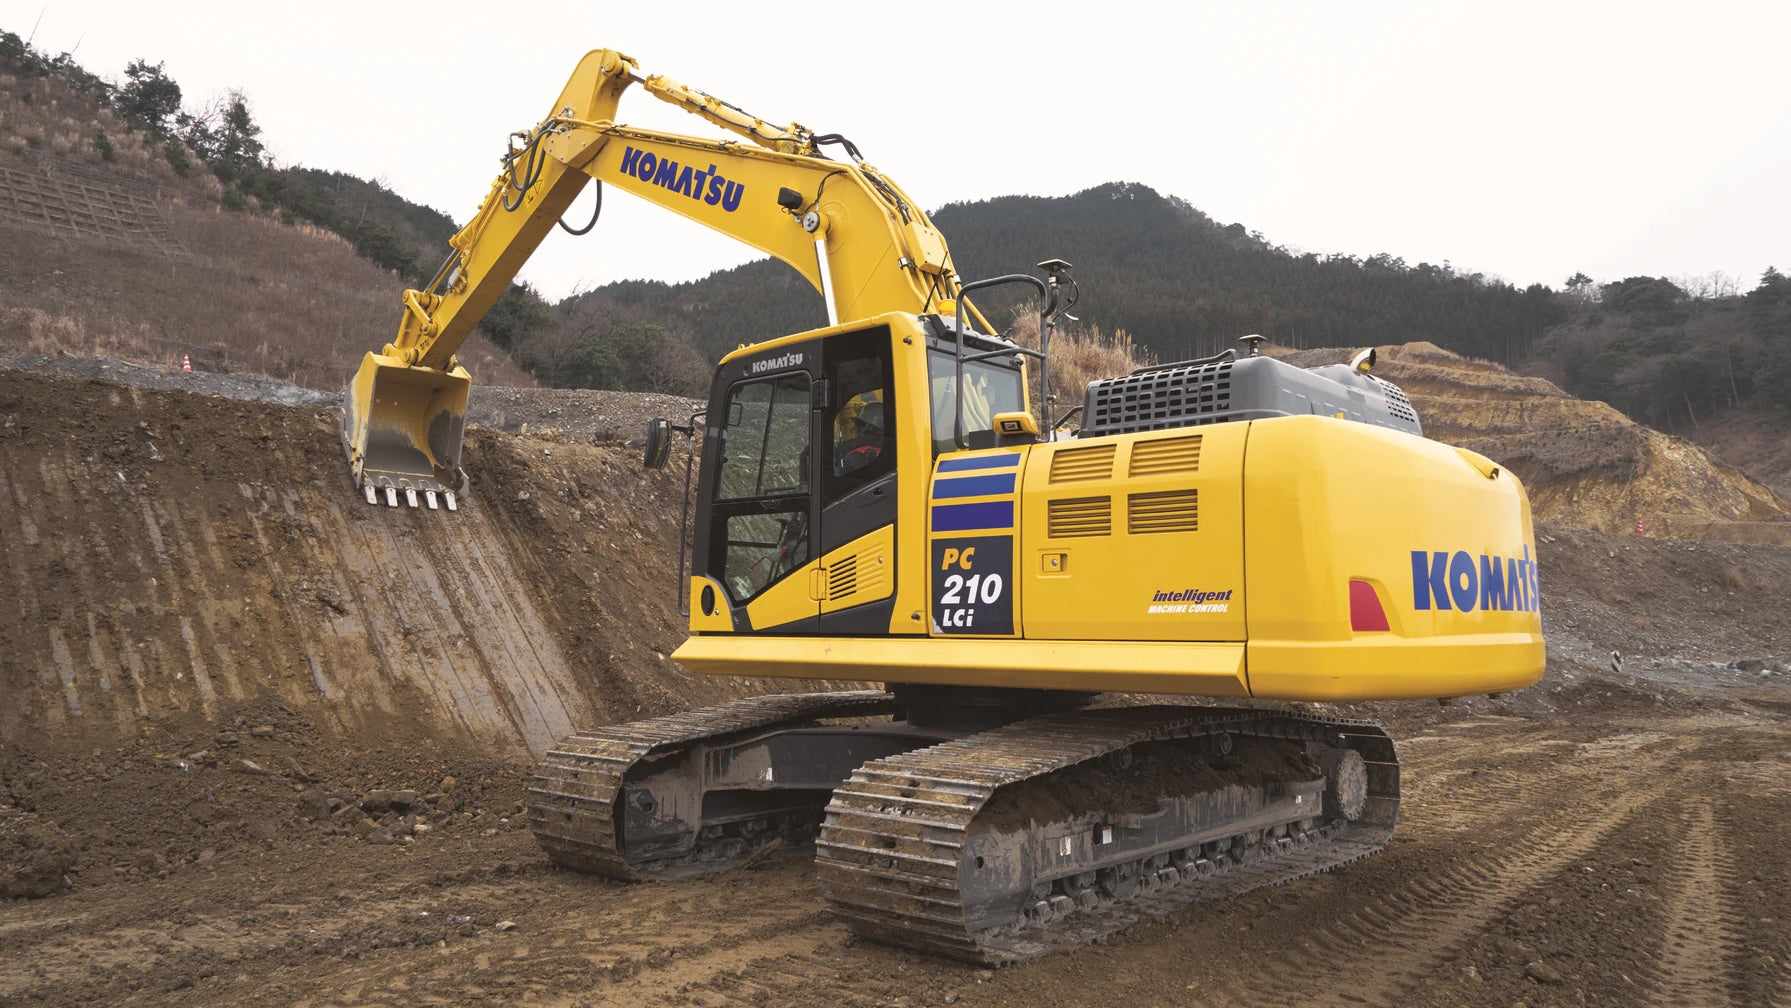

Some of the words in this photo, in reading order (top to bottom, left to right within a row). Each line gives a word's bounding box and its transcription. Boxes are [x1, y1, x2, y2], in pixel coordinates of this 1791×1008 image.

[620, 145, 745, 212] KOMATSU
[752, 352, 803, 373] KOMATSU
[941, 547, 975, 570] PC
[940, 573, 1003, 604] 210
[1410, 544, 1540, 613] KOMATS
[1152, 589, 1233, 604] intelligent
[942, 608, 974, 627] LCi
[1147, 604, 1188, 614] MACHINE
[1188, 603, 1229, 613] CONTROL
